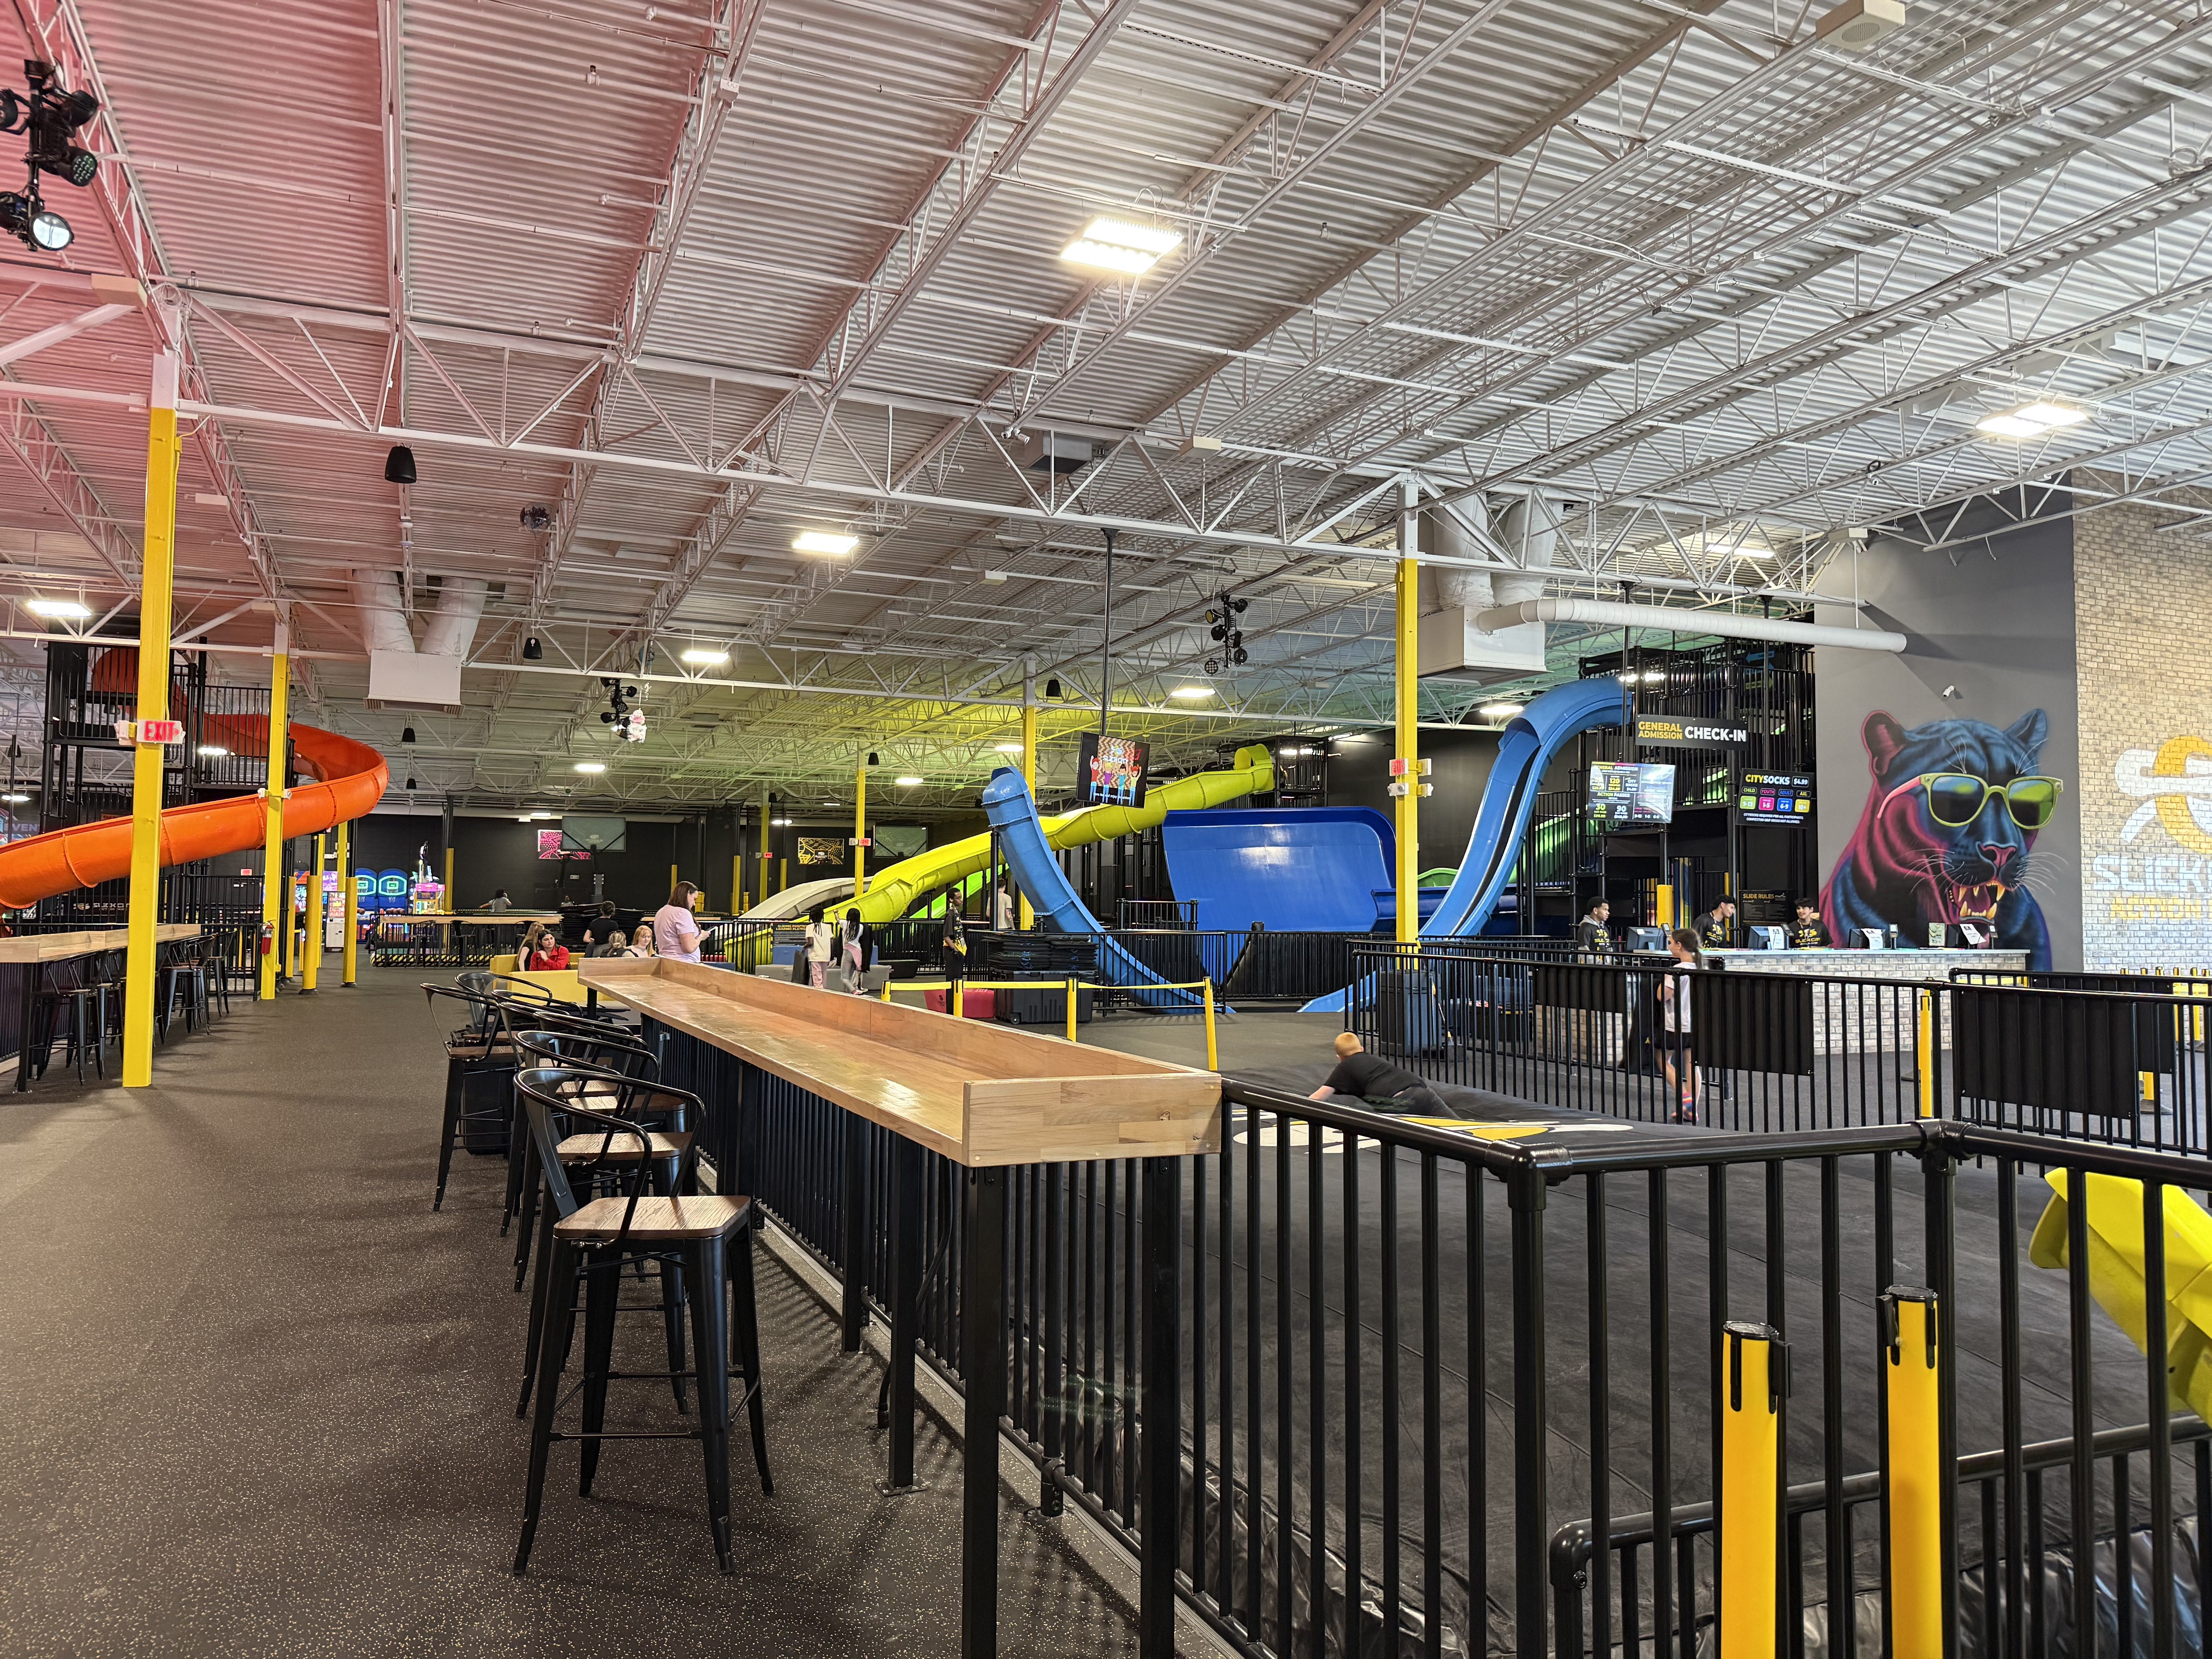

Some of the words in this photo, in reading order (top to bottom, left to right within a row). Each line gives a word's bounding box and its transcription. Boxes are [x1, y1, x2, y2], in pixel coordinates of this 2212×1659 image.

[144, 721, 176, 742] EXIT
[1638, 721, 1682, 732] GENERAL
[1685, 726, 1746, 742] CHECK-IN
[1638, 731, 1683, 740] ADMISSION
[1391, 759, 1404, 775] EXIT
[1745, 774, 1790, 785] CITYSOCKS
[2093, 854, 2204, 892] SLICK
[2110, 896, 2202, 920] ACTION
